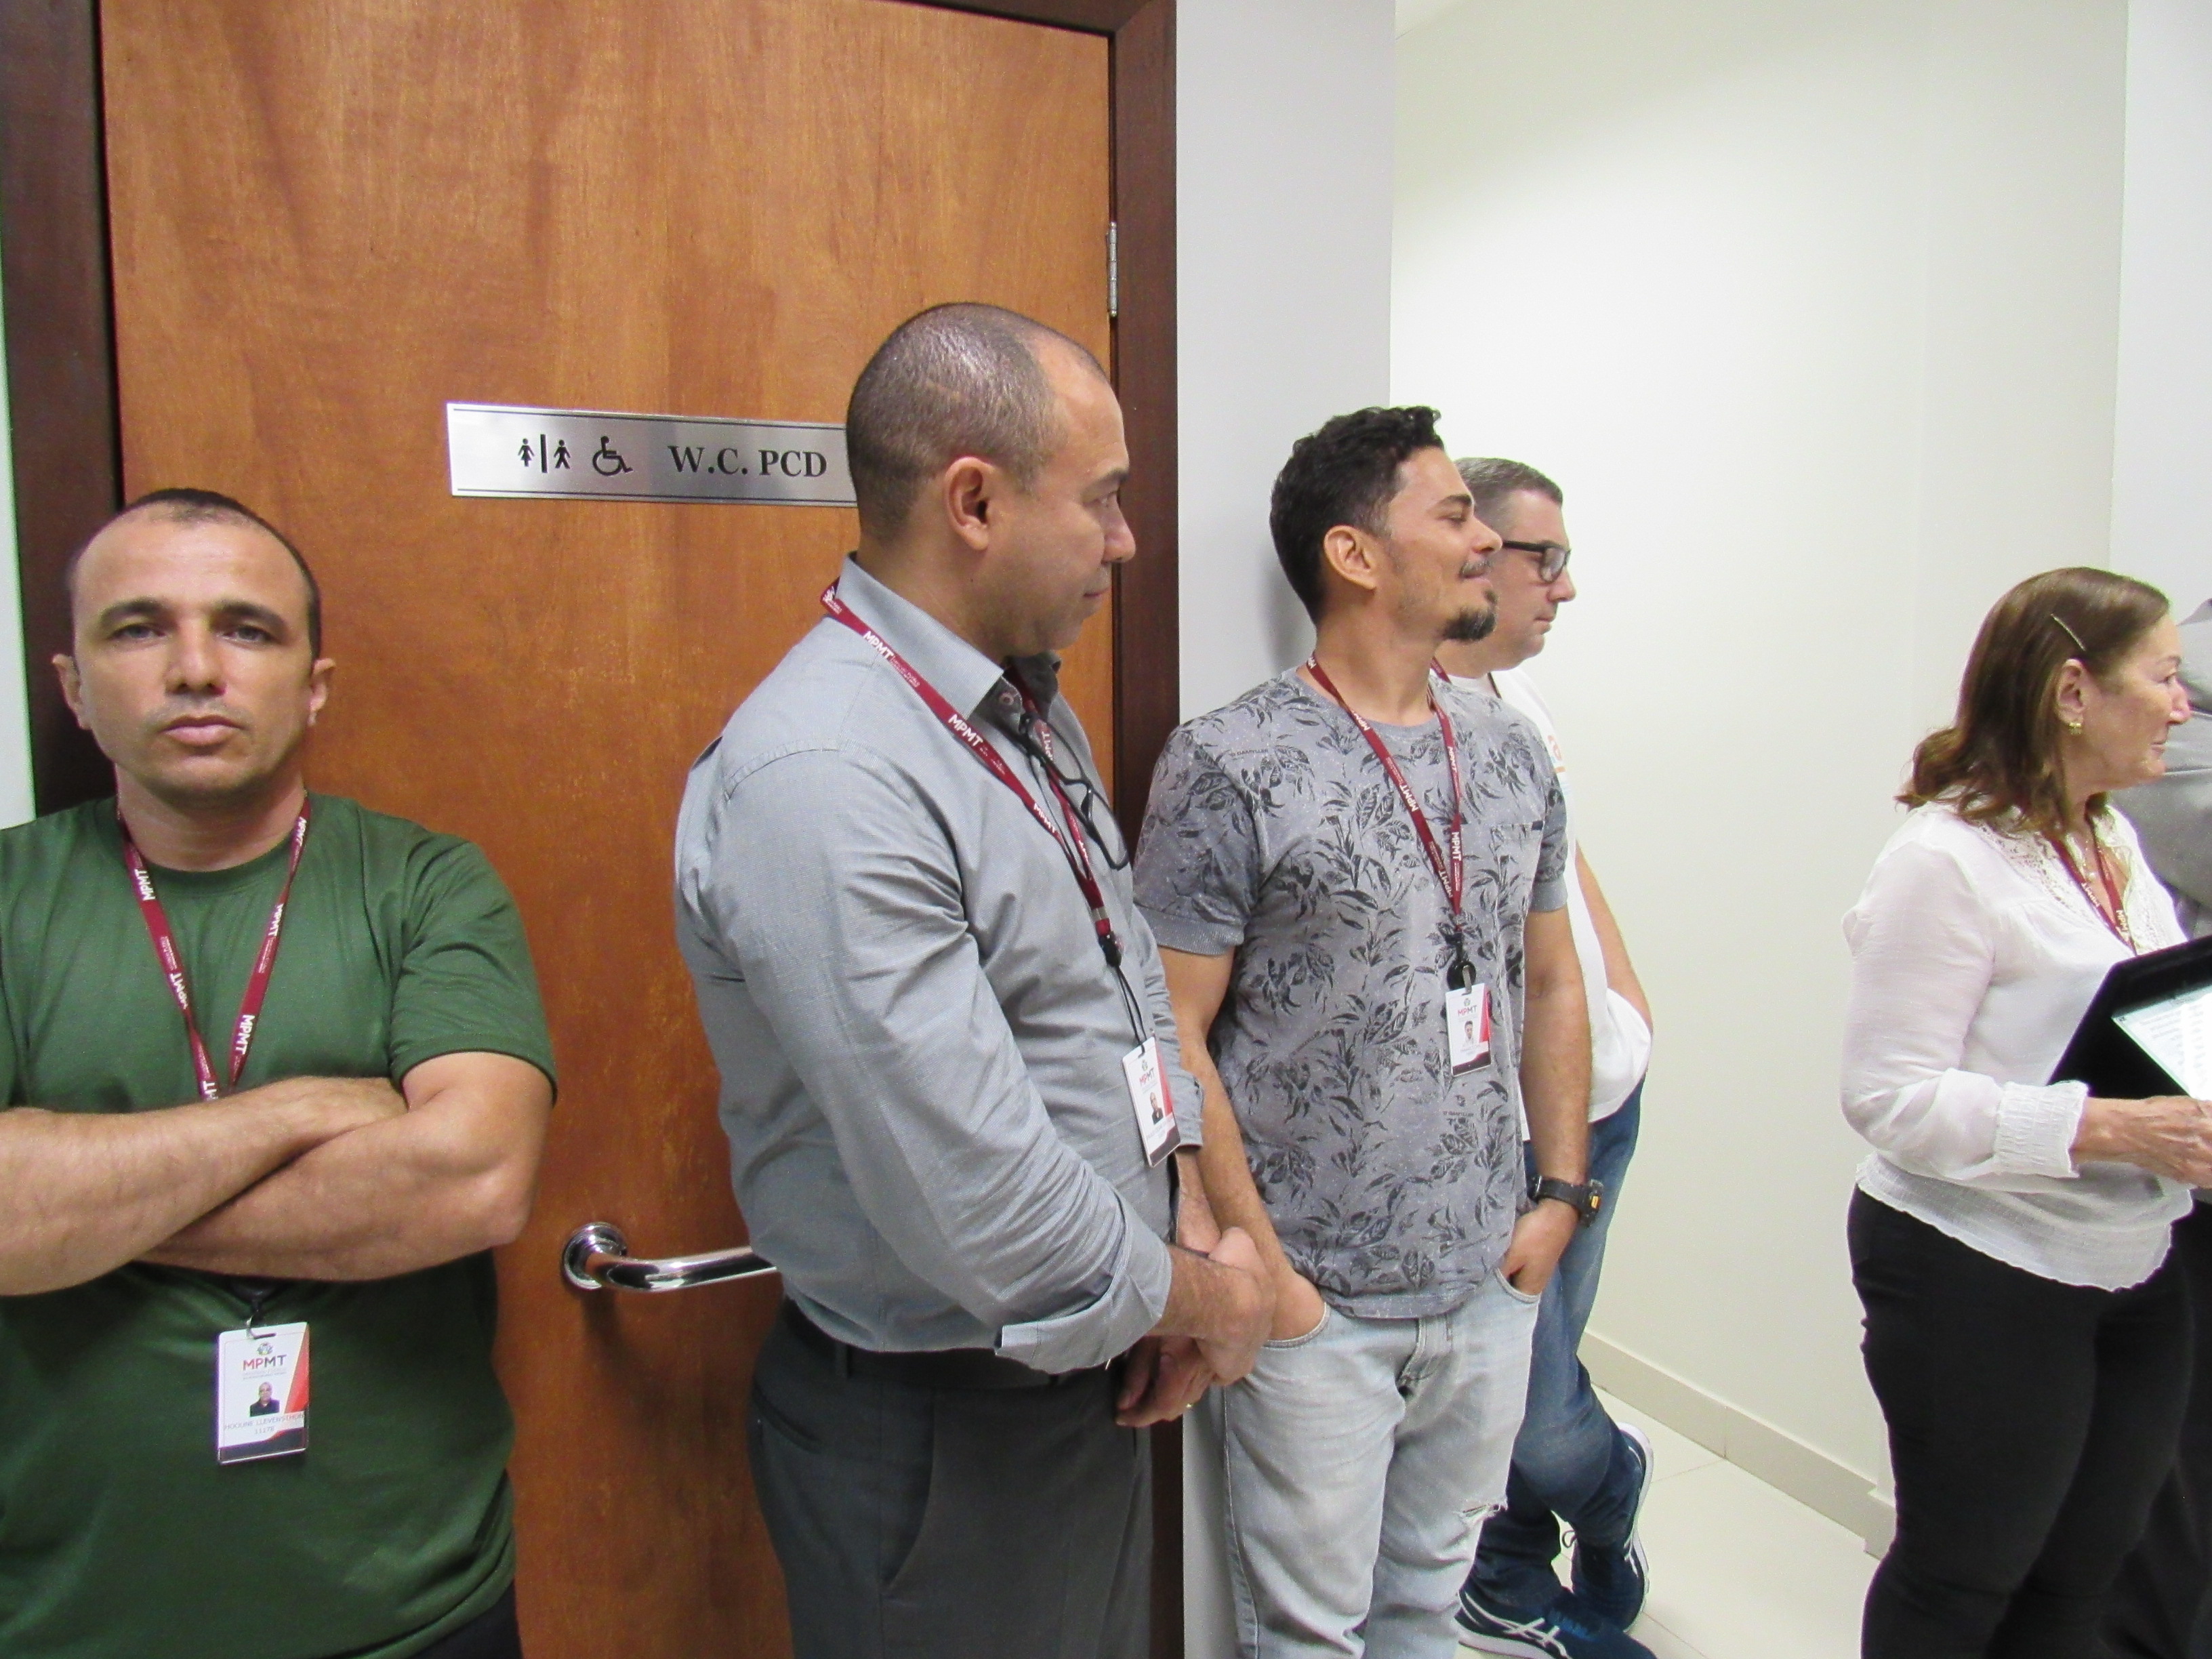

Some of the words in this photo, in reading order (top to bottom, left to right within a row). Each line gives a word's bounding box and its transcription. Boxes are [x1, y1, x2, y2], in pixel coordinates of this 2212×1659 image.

[668, 445, 748, 475] W.C.
[759, 449, 827, 478] PCD
[863, 630, 894, 659] MPMT
[948, 714, 983, 746] MPMT
[1399, 785, 1419, 812] MPMT
[1033, 802, 1056, 834] MPMT
[1452, 831, 1462, 861] MPMT
[134, 868, 156, 901] MPMT
[1438, 869, 1453, 898] MPMT
[268, 903, 284, 937] MPMT
[170, 972, 188, 1010] MPMT
[1458, 1004, 1477, 1017] MPMT
[235, 1015, 255, 1055] MPMT
[1139, 1067, 1155, 1086] MPMT
[243, 1354, 287, 1370] MPMT
